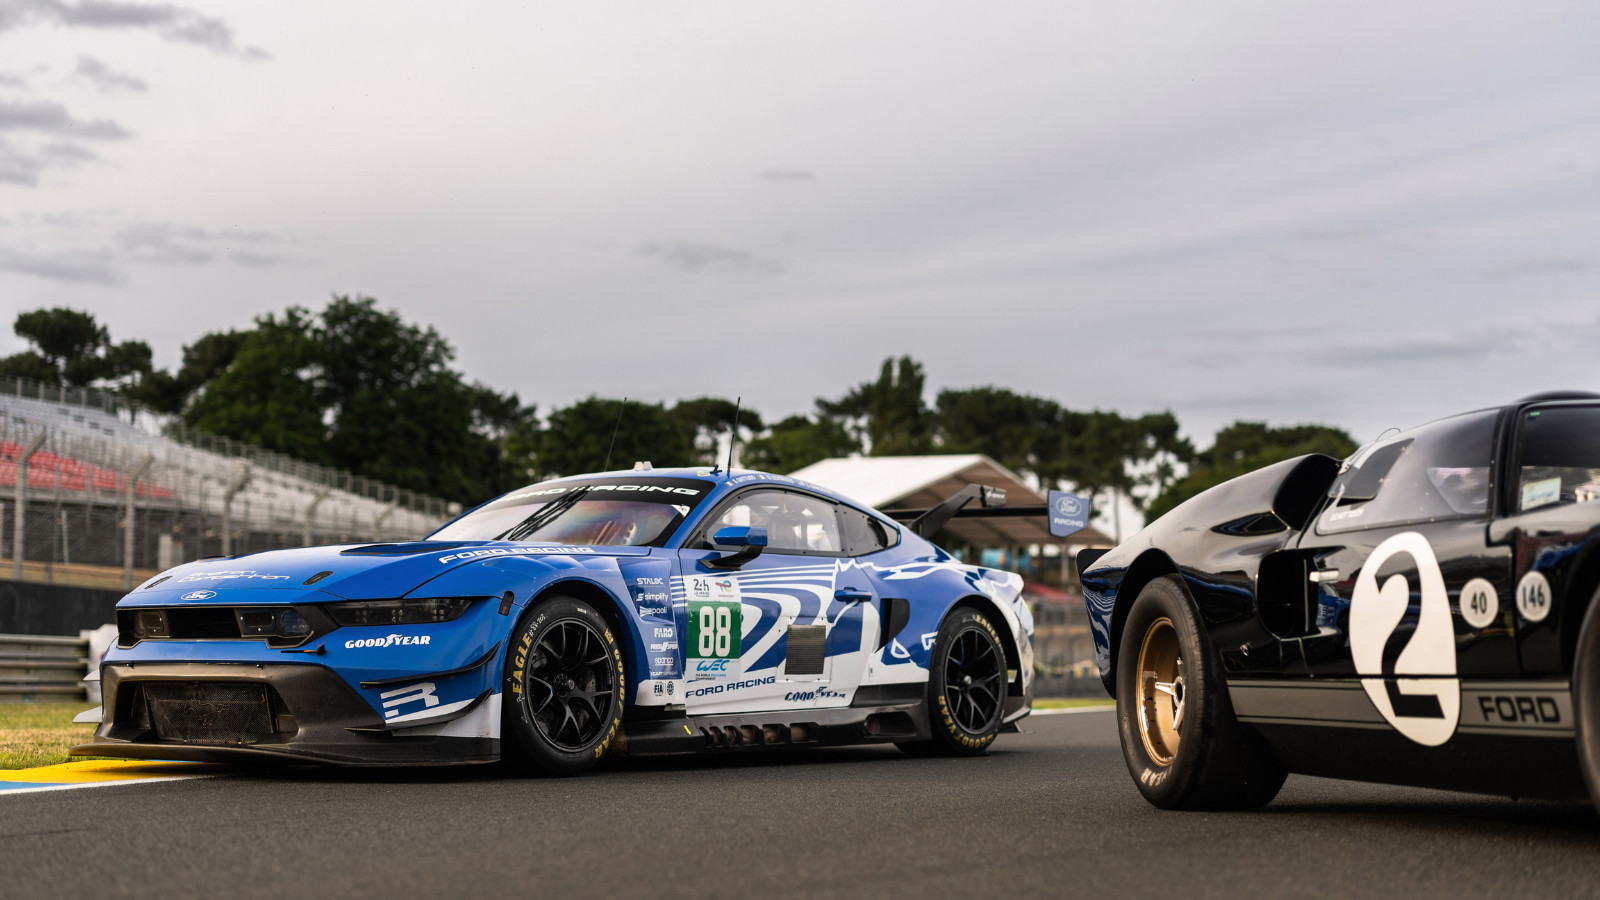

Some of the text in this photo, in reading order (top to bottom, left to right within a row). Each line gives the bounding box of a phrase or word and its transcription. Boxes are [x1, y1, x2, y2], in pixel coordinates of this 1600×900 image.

[1054, 517, 1084, 528] RACING
[438, 549, 509, 564] FORD
[644, 592, 669, 602] simplify
[1470, 591, 1487, 614] 40
[1522, 584, 1545, 609] 146
[653, 627, 674, 638] FARO
[698, 605, 732, 658] 88
[976, 614, 999, 645] EAGLE
[1374, 550, 1446, 719] 2
[344, 634, 431, 649] GOODYEAR
[512, 632, 533, 694] EAGLE
[696, 658, 731, 672] WEC
[654, 684, 663, 694] FIA
[685, 676, 776, 698] FORD RACING
[595, 648, 625, 759] GOODYEAR
[1477, 696, 1561, 723] FORD
